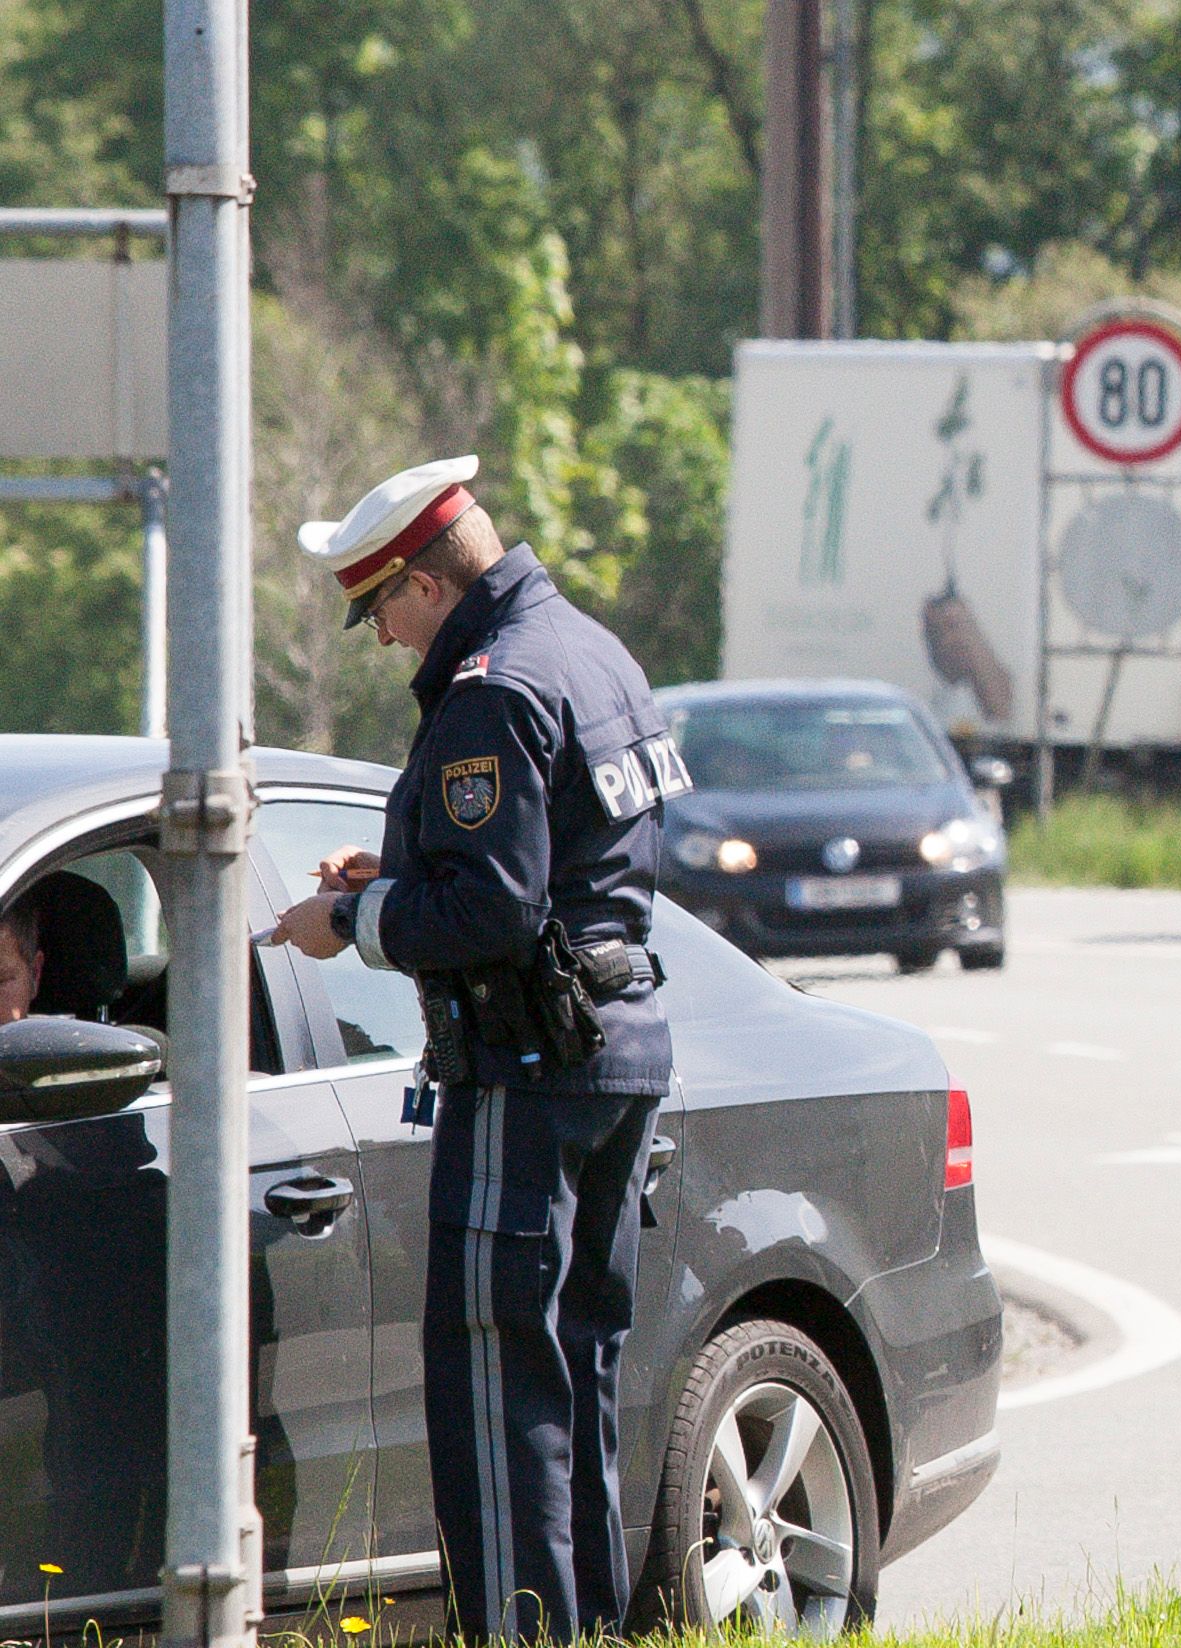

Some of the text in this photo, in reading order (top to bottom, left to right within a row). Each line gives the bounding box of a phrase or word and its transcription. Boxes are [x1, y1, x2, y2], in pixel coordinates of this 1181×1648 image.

[1101, 358, 1166, 427] 80
[446, 761, 493, 780] POLIZEI
[736, 1341, 835, 1390] POTENZA
